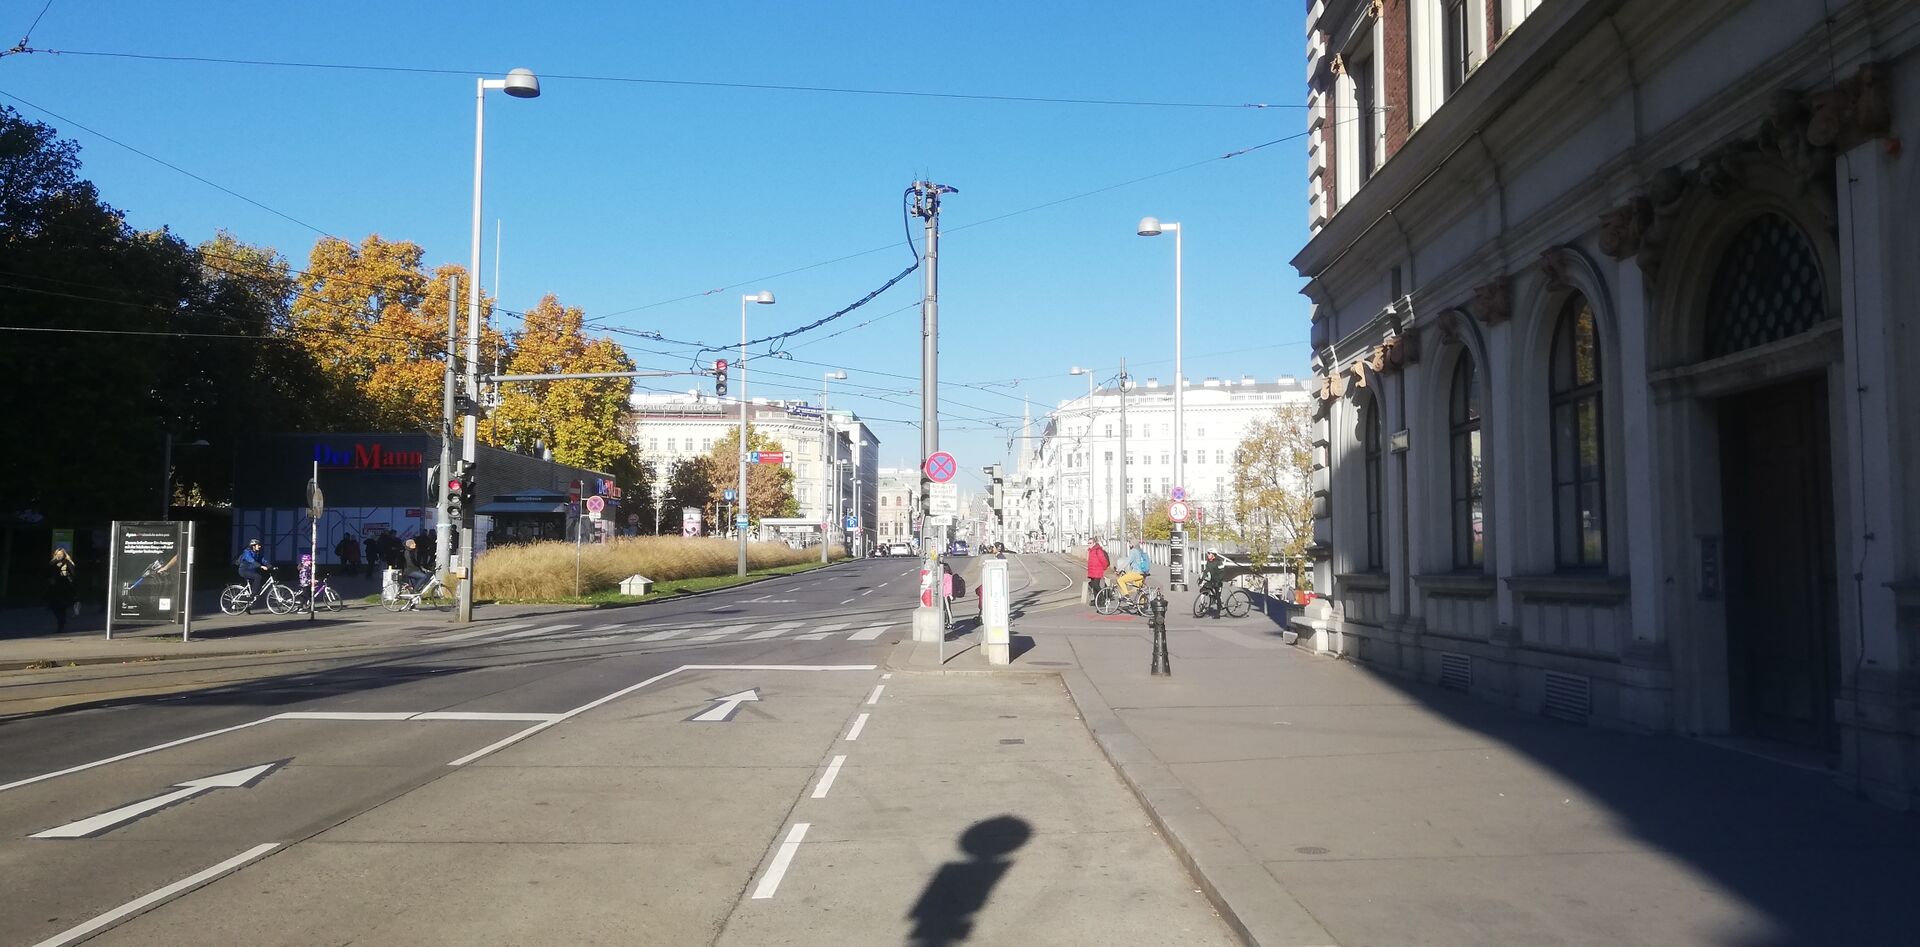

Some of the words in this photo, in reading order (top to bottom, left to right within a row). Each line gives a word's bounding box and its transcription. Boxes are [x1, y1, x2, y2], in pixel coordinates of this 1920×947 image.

[314, 443, 351, 465] Der
[354, 443, 423, 470] Mann
[725, 491, 732, 500] U
